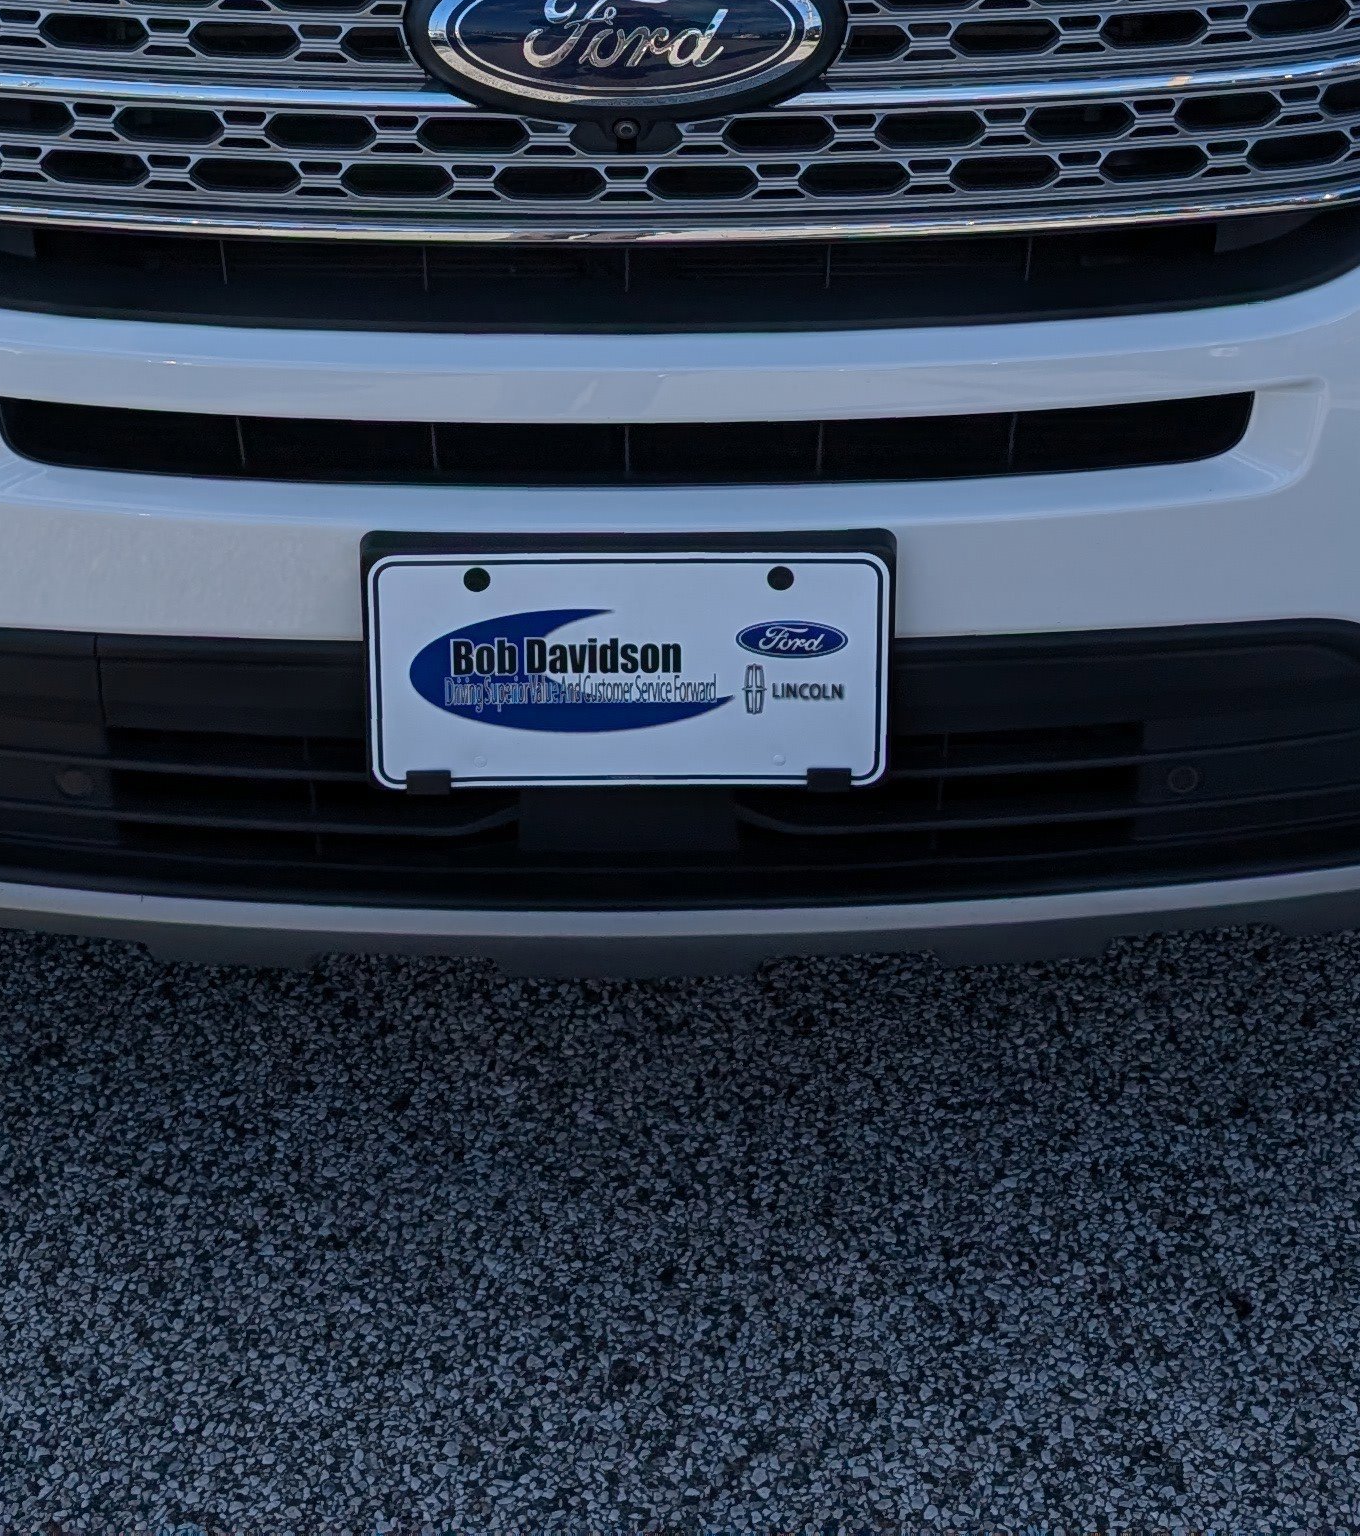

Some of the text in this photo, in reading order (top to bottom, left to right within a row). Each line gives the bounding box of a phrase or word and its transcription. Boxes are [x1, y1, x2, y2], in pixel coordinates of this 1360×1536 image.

[758, 626, 825, 651] Ford
[451, 637, 682, 676] Bob Davidson
[444, 673, 717, 713] Driving Superior Value And Customer Service Forward
[771, 683, 844, 700] LINCOLN
